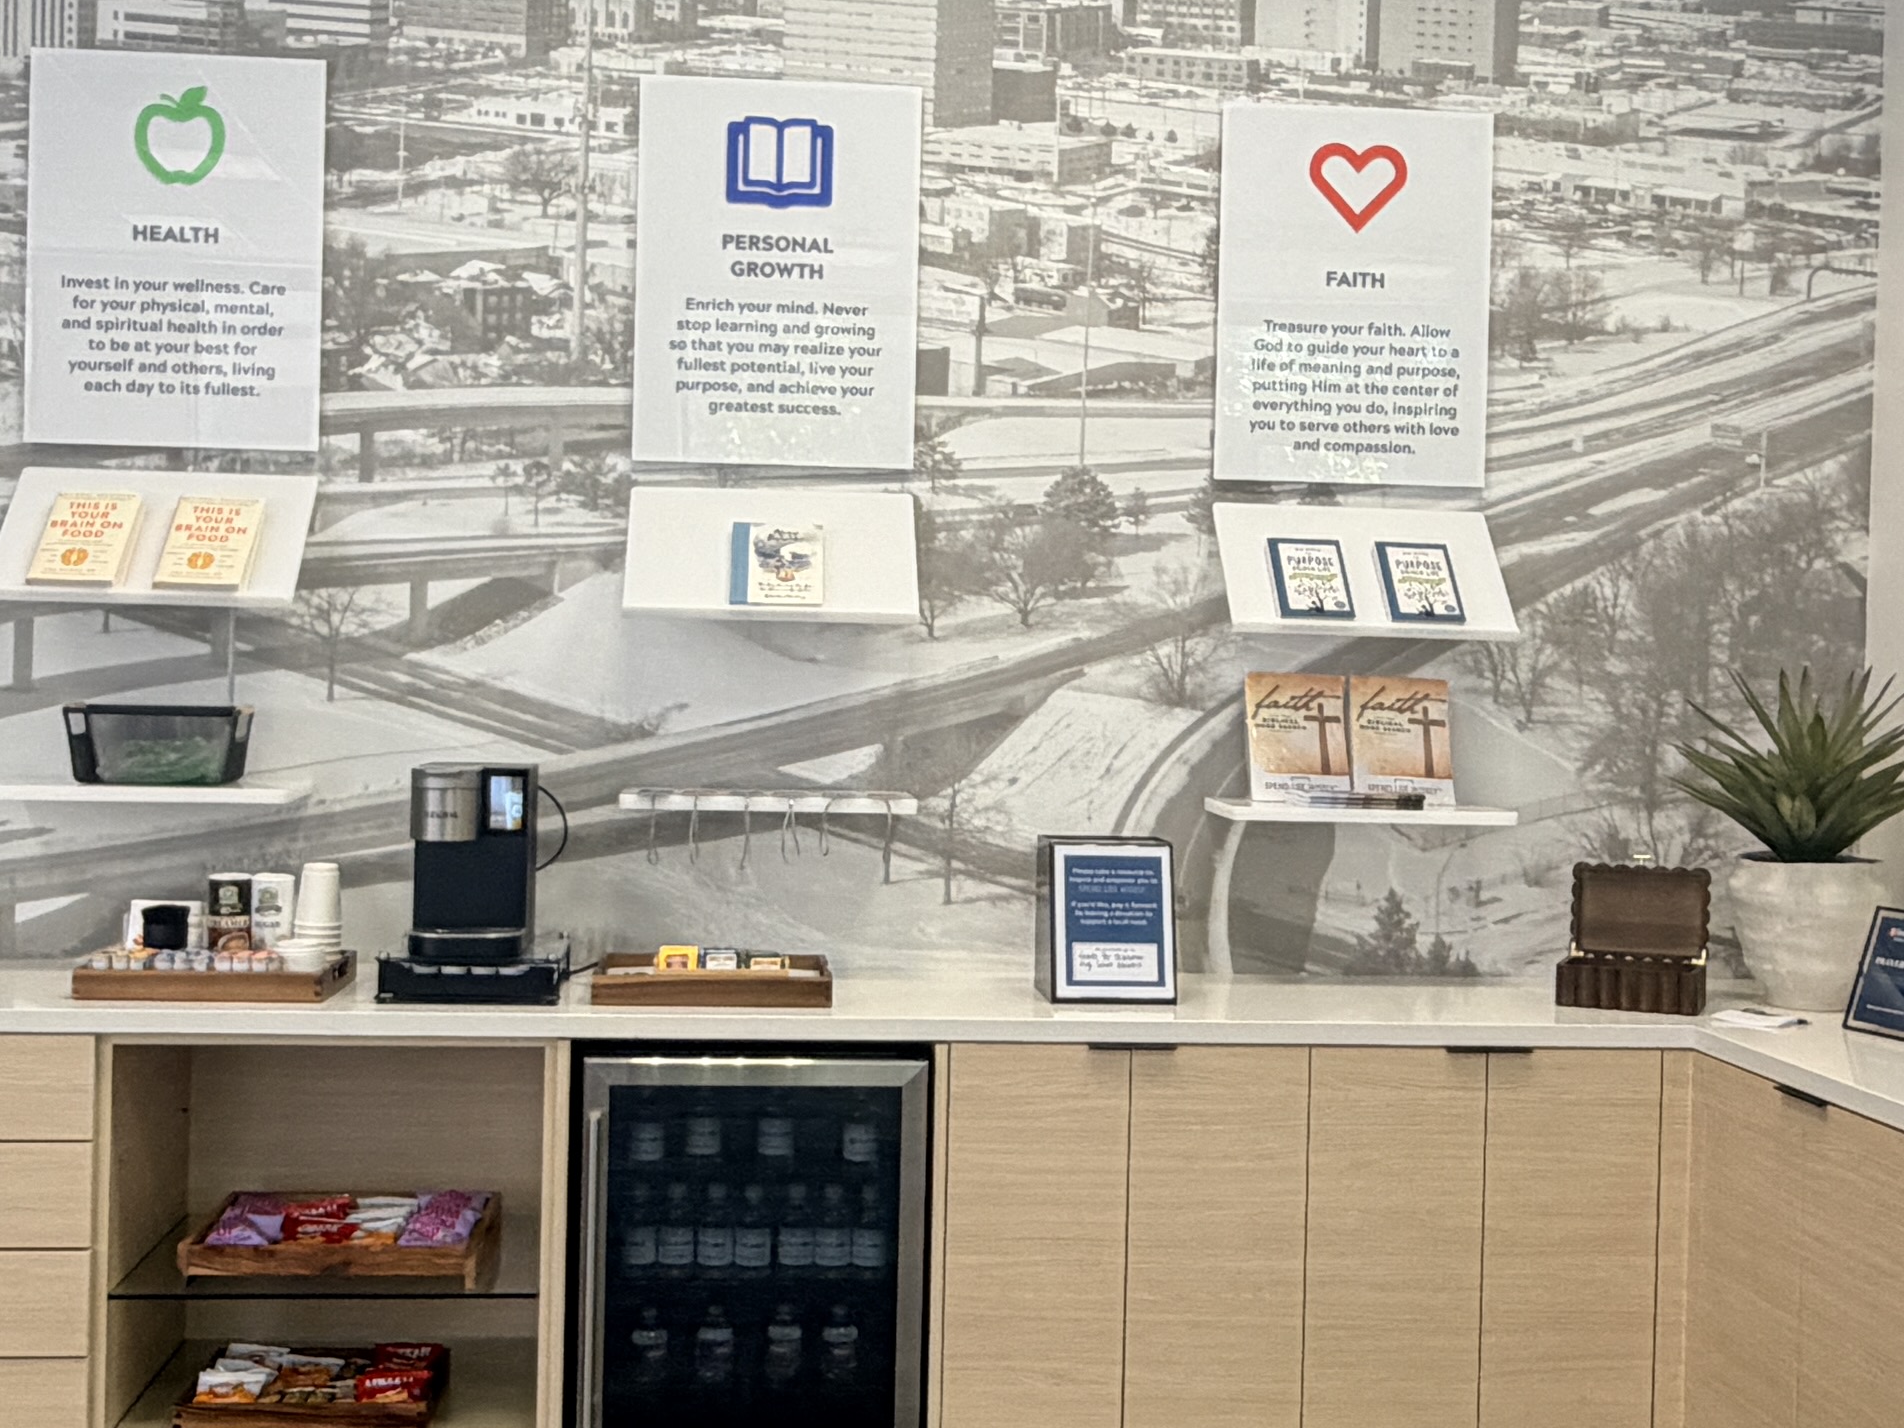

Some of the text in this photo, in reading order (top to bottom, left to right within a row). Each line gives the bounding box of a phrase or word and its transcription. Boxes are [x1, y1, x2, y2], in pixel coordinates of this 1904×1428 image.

[132, 225, 219, 244] HEALTH
[722, 234, 834, 254] PERSONAL
[730, 261, 824, 279] GROWTH
[61, 275, 286, 296] Invest in your wellness. Care
[1326, 271, 1385, 288] FAITH
[72, 295, 274, 317] for your physical, mental,
[685, 297, 869, 316] Enrich your mind. Never
[61, 317, 284, 336] and spiritual health in order
[677, 319, 876, 340] stop learning and growing
[1264, 319, 1451, 338] Treasure your faith. Allow
[88, 338, 257, 356] to be at your best for
[669, 338, 882, 359] so that you may realize your
[1254, 338, 1460, 358] God to guide your heart to a
[68, 358, 276, 380] yourself and others, living
[676, 357, 874, 378] fullest potential, live your
[1252, 358, 1460, 380] life of meaning and purpose,
[84, 379, 260, 397] each day to its fullest.
[675, 380, 875, 398] purpose, and achieve your
[1252, 379, 1458, 397] putting Him at the center of
[708, 402, 842, 416] greatest success.
[1252, 399, 1457, 420] everything you do, inspiring
[1249, 420, 1460, 436] you to serve others with love
[1293, 438, 1416, 455] and compassion.
[70, 502, 99, 510] THIS
[71, 511, 110, 519] YOUR
[194, 506, 241, 516] THIS IS
[50, 520, 123, 529] BRAIN ON
[175, 524, 247, 534] BRAIN ON
[196, 516, 234, 524] YOUR
[62, 529, 104, 537] FOOD
[187, 534, 229, 542] FOOD
[1287, 556, 1334, 566] PURPOSE
[1395, 559, 1442, 571] PURPOSE
[1251, 684, 1341, 720] faith
[1356, 685, 1447, 722] faith
